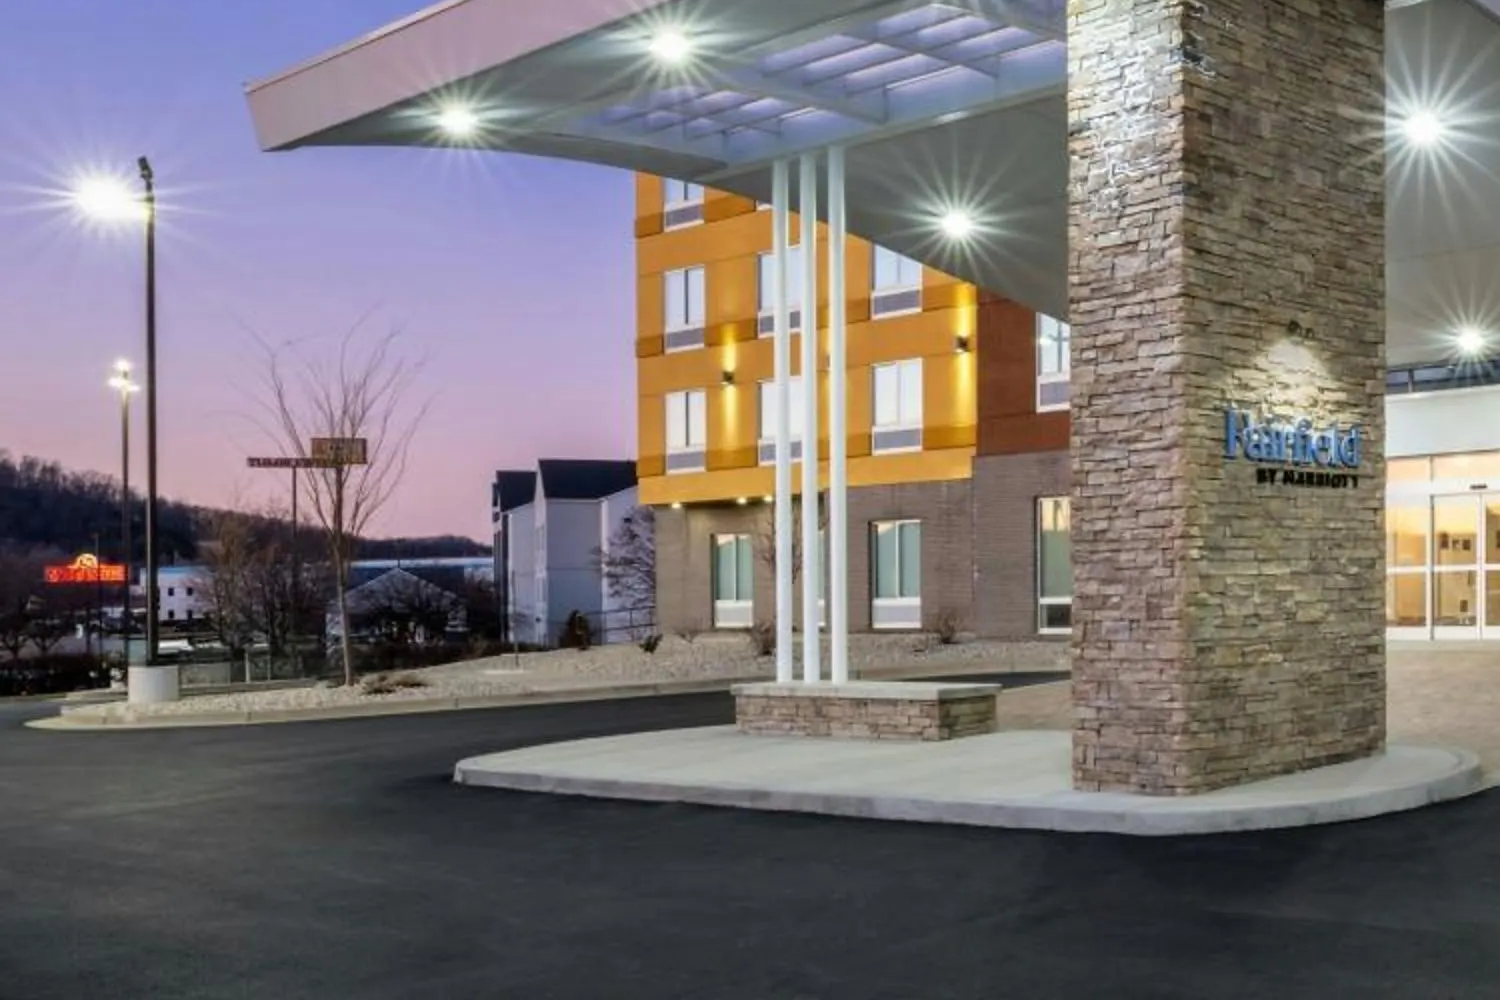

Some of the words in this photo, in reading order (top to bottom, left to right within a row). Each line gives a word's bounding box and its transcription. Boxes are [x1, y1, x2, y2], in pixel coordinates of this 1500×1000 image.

[1224, 407, 1362, 468] Fairfield
[1256, 468, 1278, 486] BY
[1283, 471, 1359, 489] MARRIOTT
